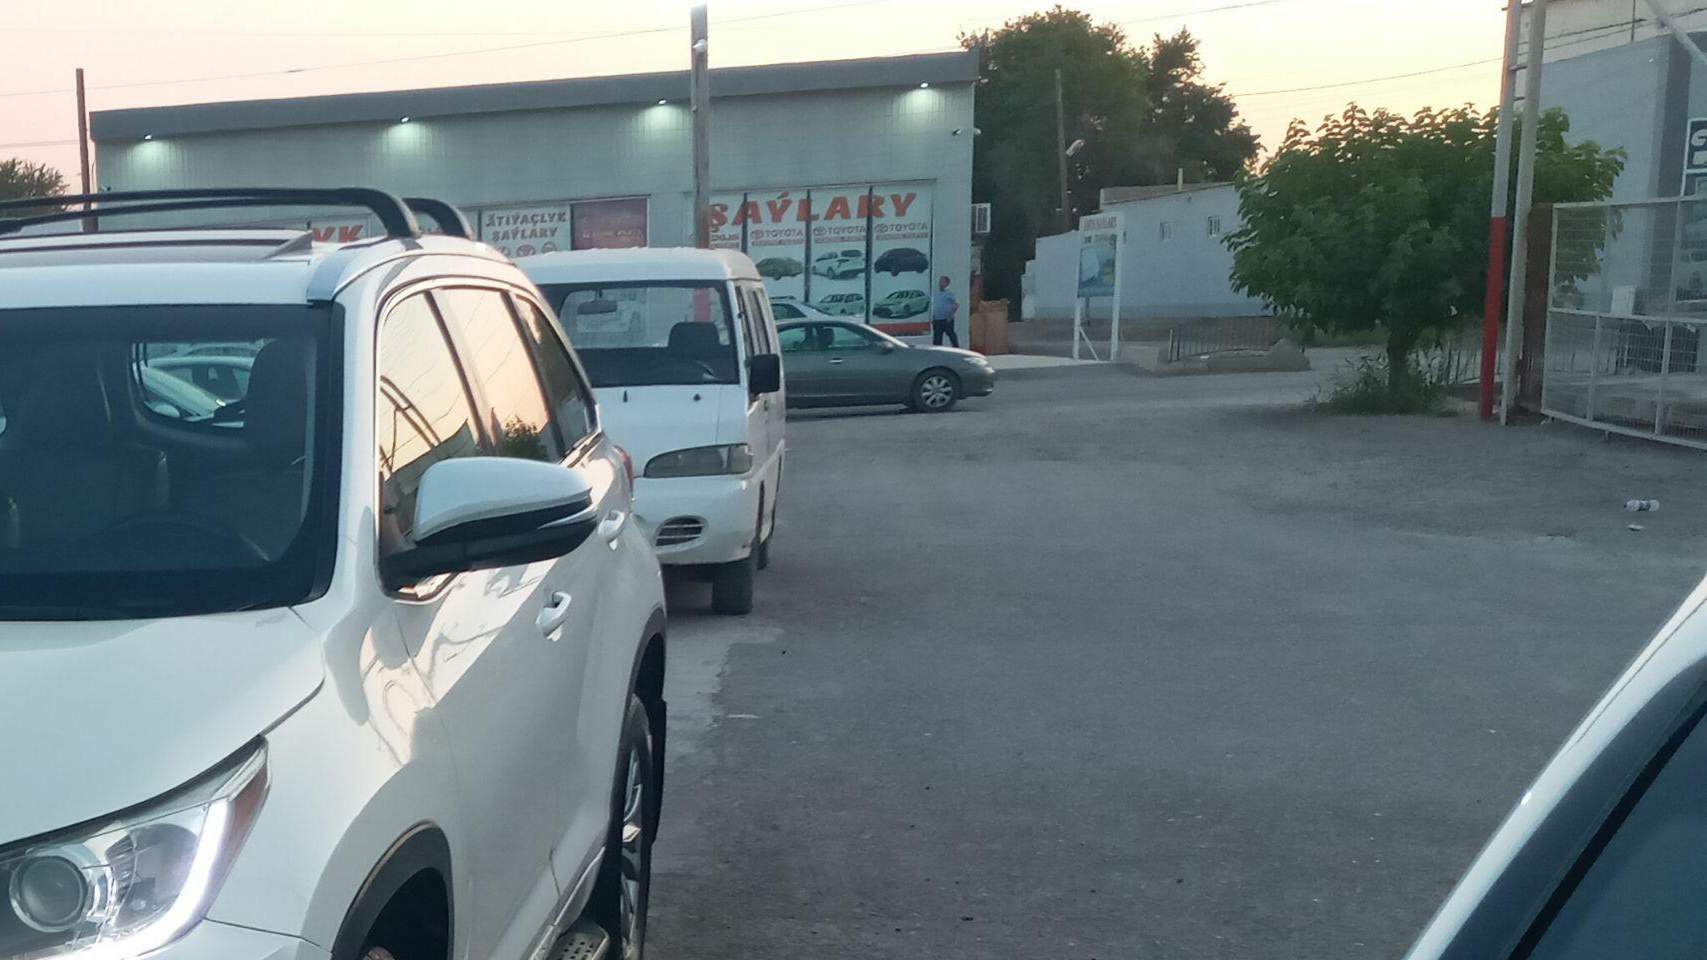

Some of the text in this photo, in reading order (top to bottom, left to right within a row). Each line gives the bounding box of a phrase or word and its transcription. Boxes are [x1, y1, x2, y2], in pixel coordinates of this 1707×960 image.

[826, 225, 867, 236] TOYOTA
[889, 222, 928, 232] TOYOTA
[764, 228, 804, 239] TOYOTA
